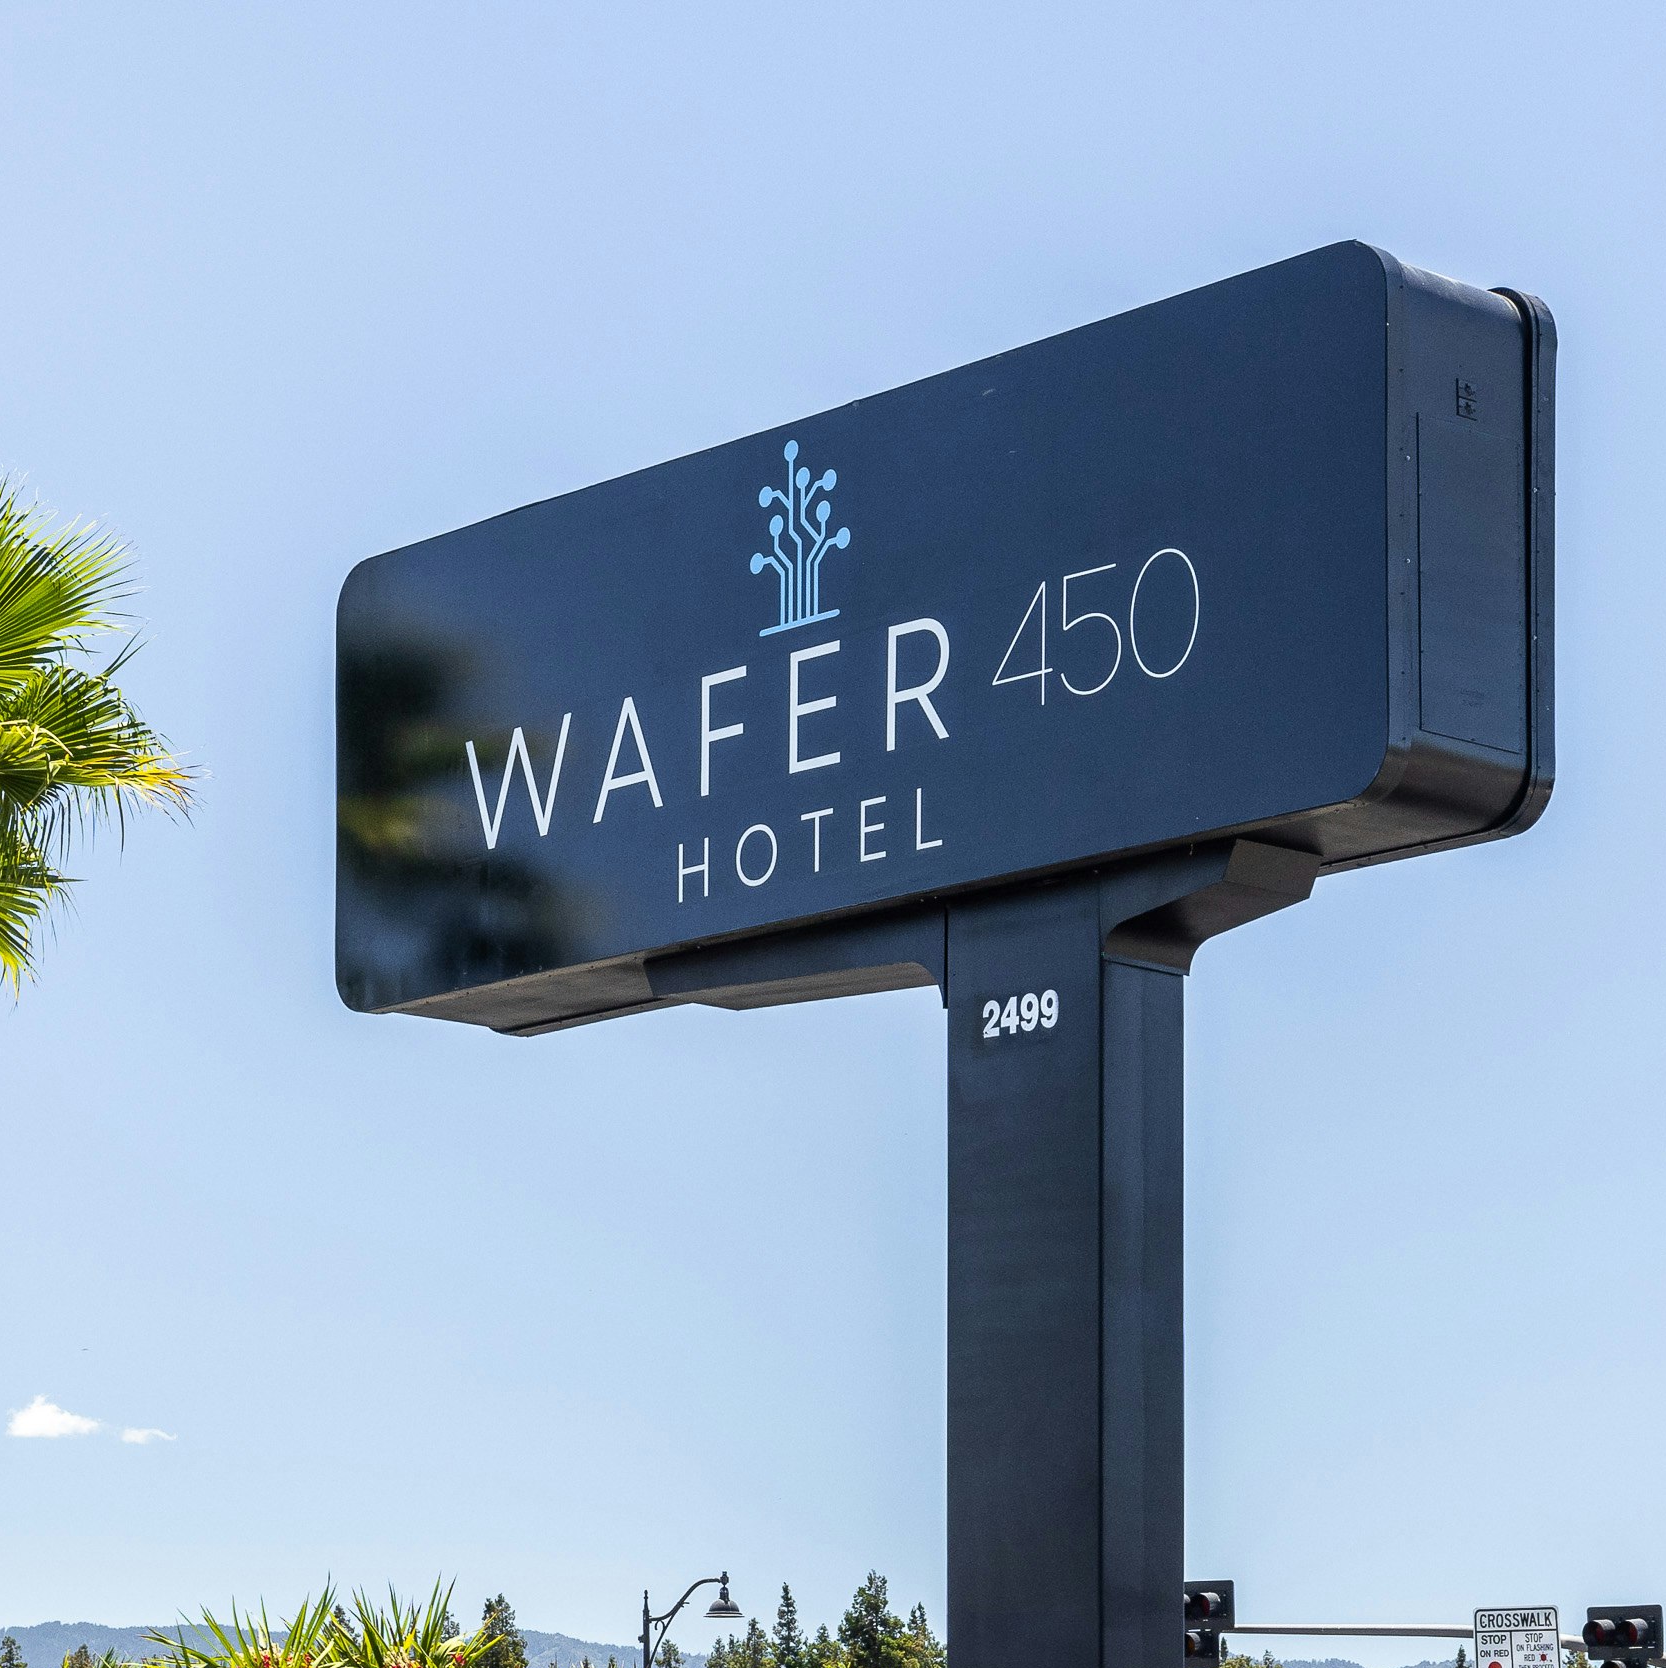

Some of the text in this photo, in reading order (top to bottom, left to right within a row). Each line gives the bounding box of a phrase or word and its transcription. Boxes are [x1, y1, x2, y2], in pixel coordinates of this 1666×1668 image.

[465, 548, 1200, 851] WAFER 450
[678, 787, 943, 903] HOTEL
[982, 989, 1060, 1039] 2499
[1479, 1612, 1553, 1629] CROSSWALK
[1481, 1634, 1507, 1645] STOP
[1524, 1633, 1544, 1643] STOP
[1516, 1643, 1554, 1652] ON FLASHING
[1479, 1649, 1510, 1658] ON RED
[1524, 1654, 1536, 1662] RED
